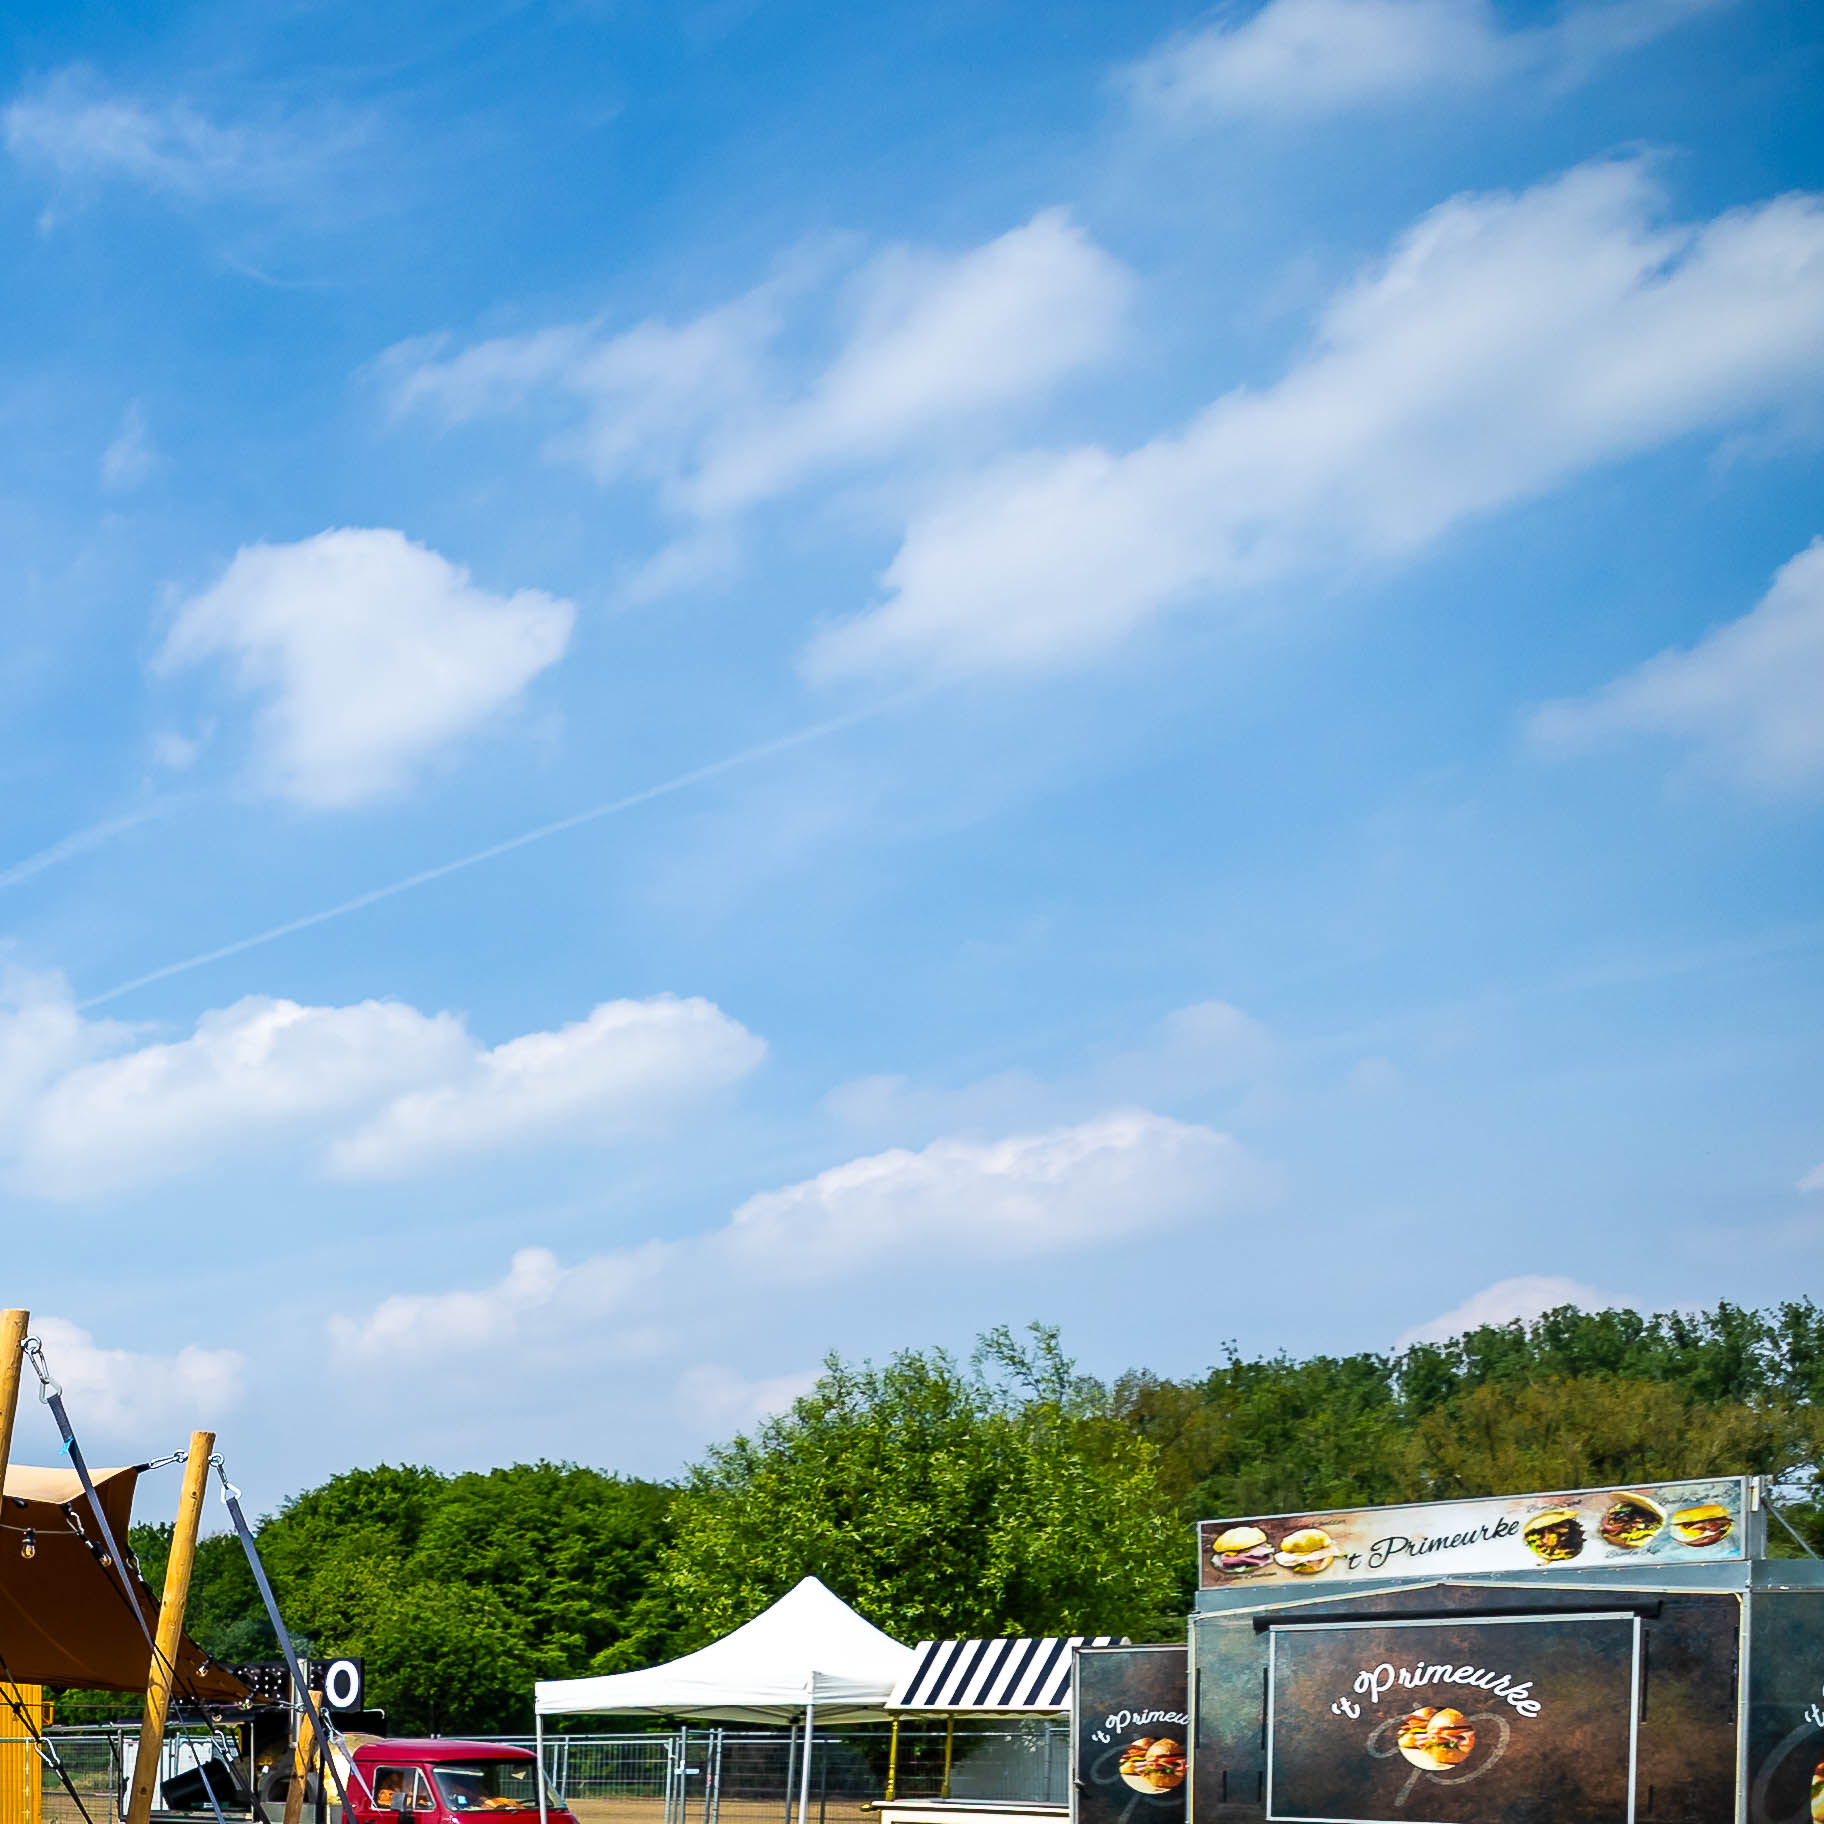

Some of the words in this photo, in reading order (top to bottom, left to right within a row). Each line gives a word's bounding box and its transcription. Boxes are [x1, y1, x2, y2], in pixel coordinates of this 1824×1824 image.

[1368, 1517, 1520, 1569] Primeurke
[1353, 1661, 1542, 1718] Primeurke
[1105, 1708, 1191, 1734] Primeu
